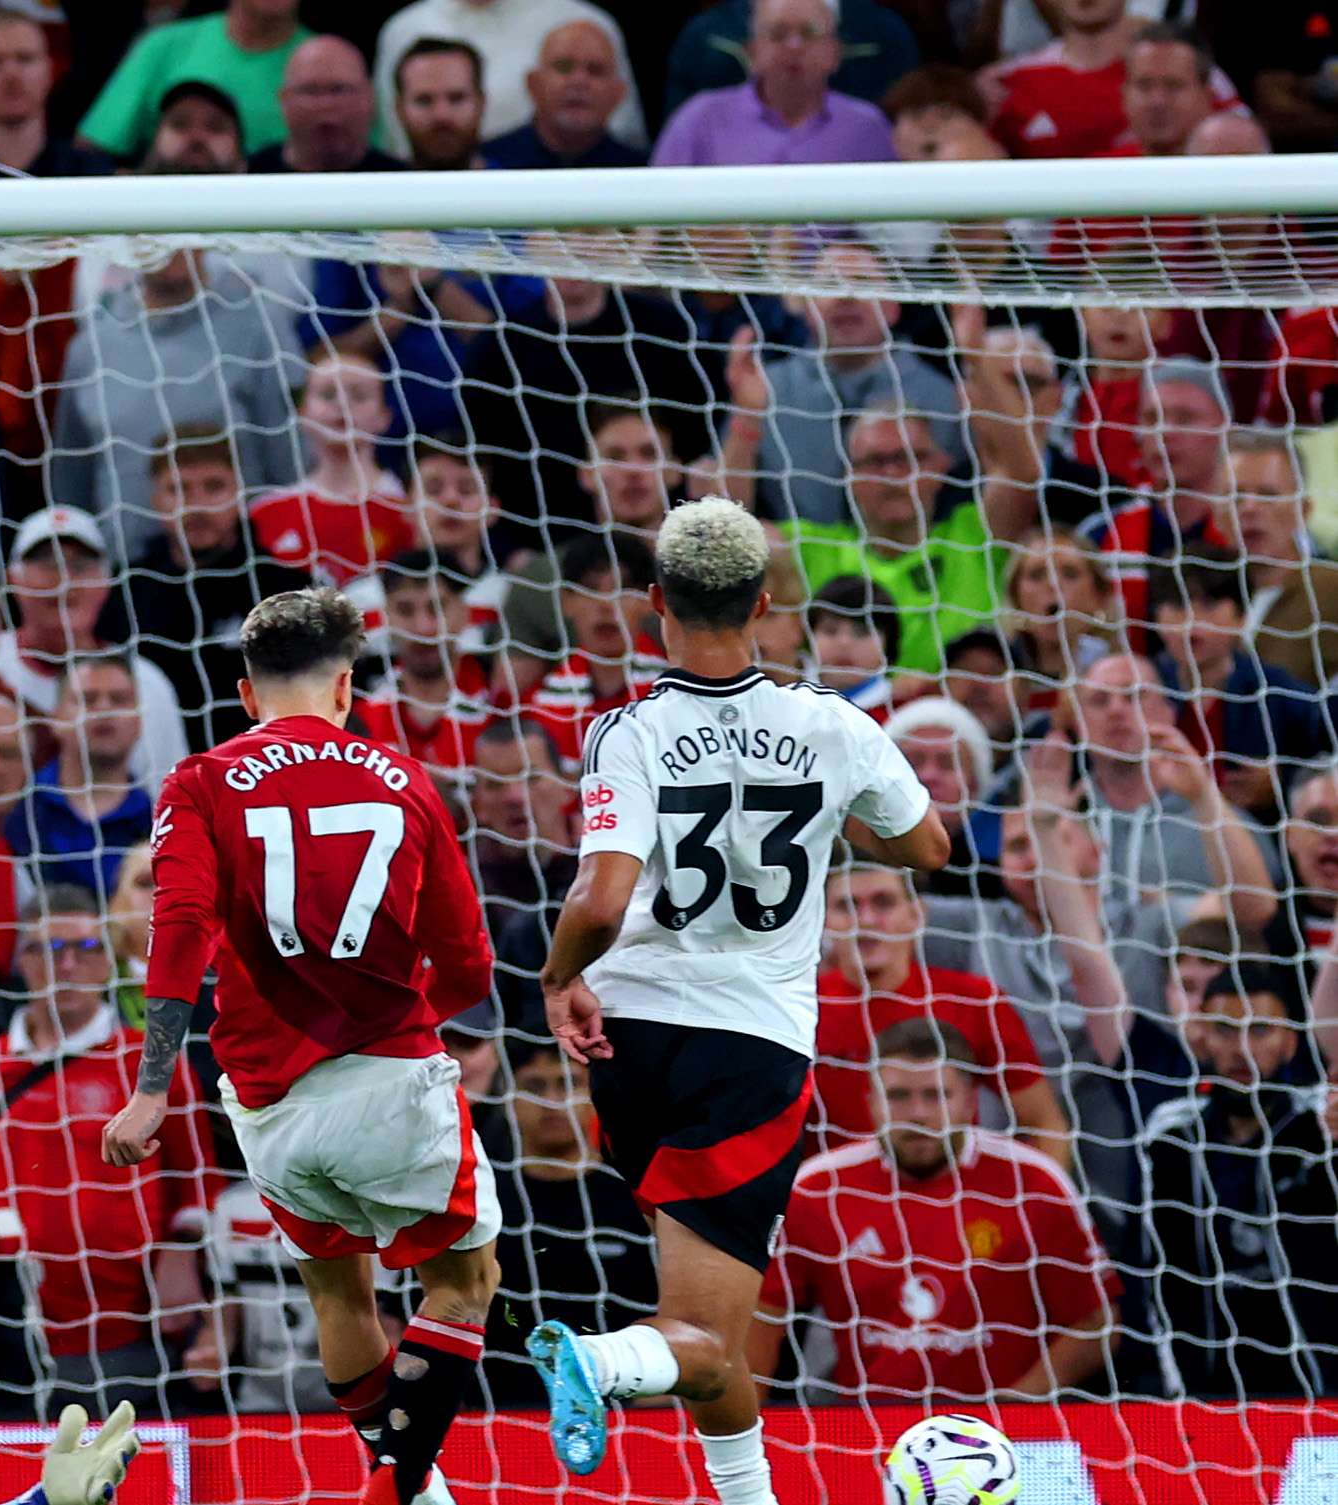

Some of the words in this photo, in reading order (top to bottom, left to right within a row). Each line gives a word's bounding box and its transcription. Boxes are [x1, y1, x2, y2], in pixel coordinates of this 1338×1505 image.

[225, 742, 409, 791] GARNACHO
[660, 726, 817, 780] ROBINSON
[585, 784, 614, 808] eb
[245, 802, 405, 959] 17
[652, 781, 823, 932] 33
